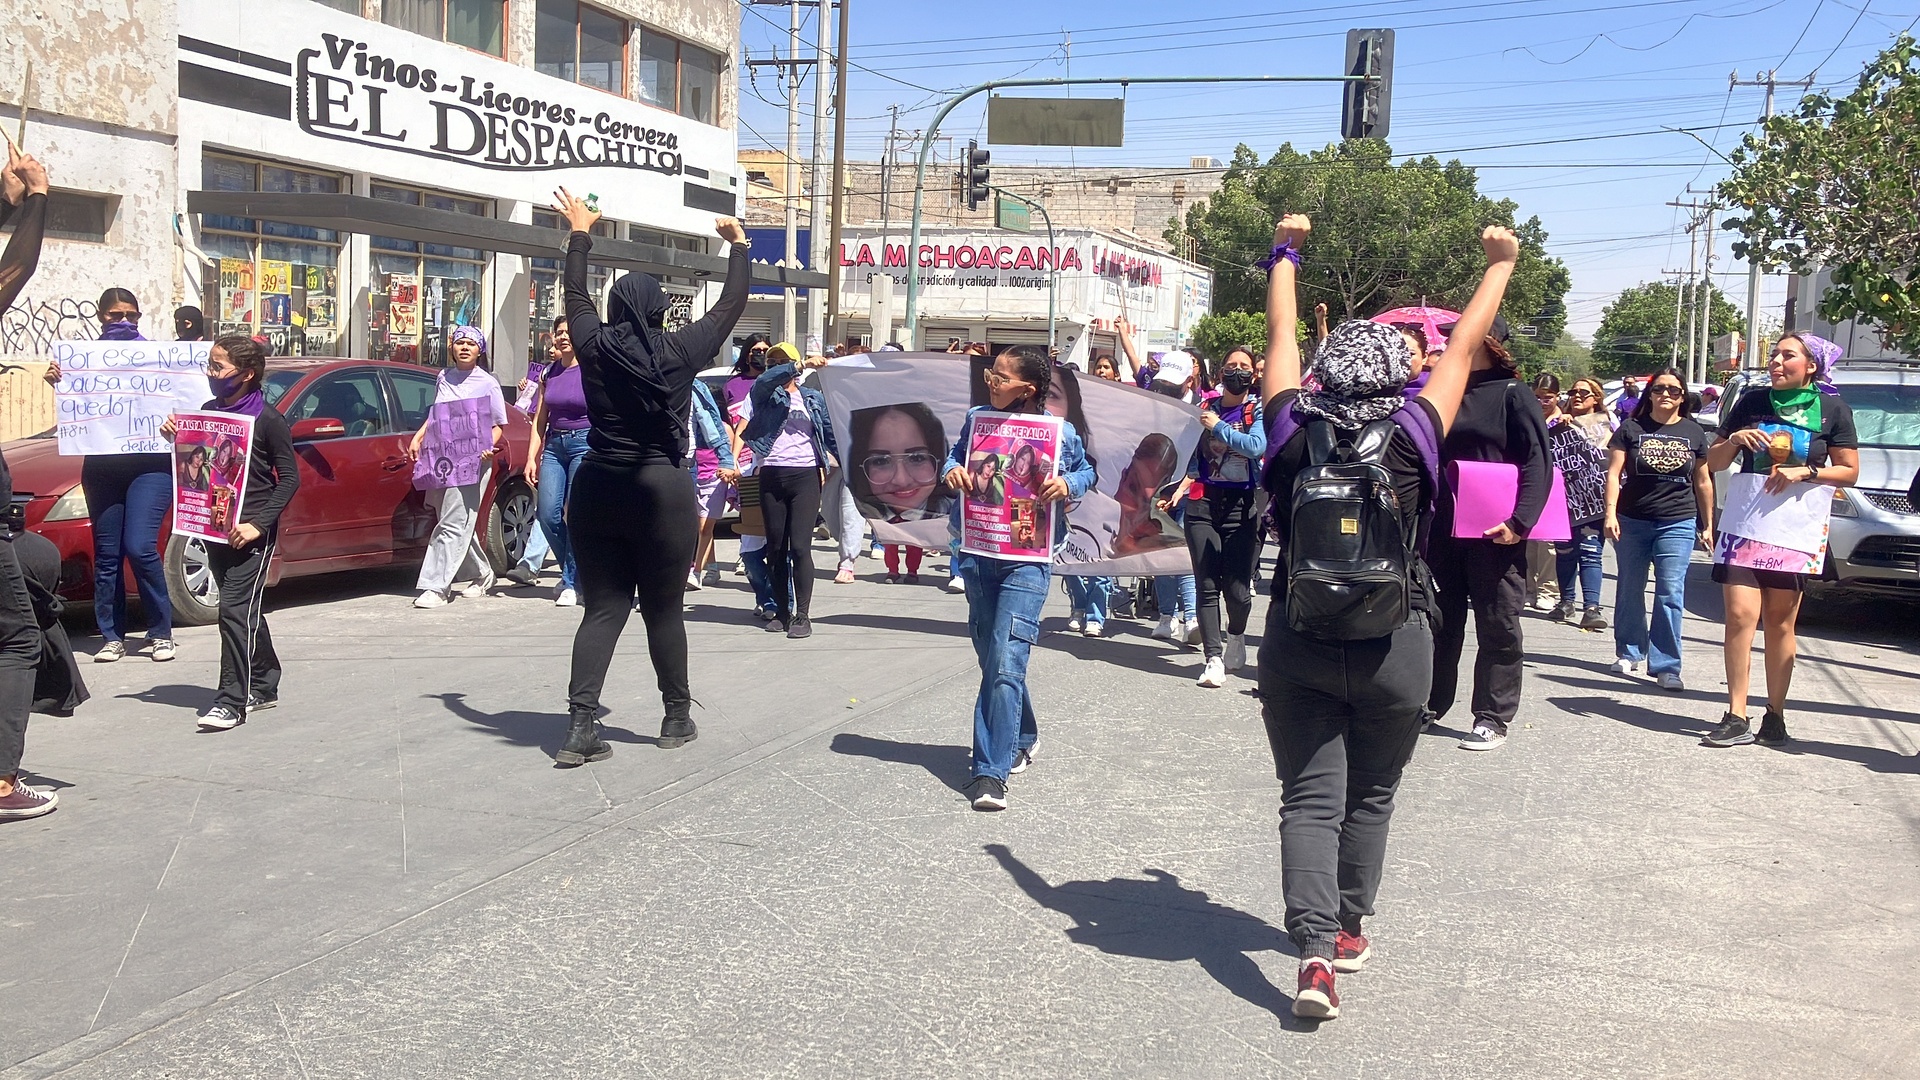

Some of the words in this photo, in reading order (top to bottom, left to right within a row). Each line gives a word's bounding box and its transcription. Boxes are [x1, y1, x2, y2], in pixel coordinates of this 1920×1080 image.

[308, 71, 407, 142] EL
[429, 100, 678, 172] DESPACHITO
[840, 243, 875, 267] LA
[959, 278, 965, 289] y
[966, 276, 997, 287] calidad
[58, 344, 96, 370] Por
[102, 348, 146, 367] ese
[1161, 361, 1183, 371] adidas
[130, 375, 172, 397] que
[61, 395, 124, 421] quedó
[59, 425, 88, 439] #8M
[177, 419, 203, 431] FALTA
[204, 421, 245, 437] ESMERALDA
[976, 423, 1000, 435] FALTA
[1001, 426, 1051, 440] ESMERALDA
[1638, 448, 1663, 456] NEW
[1664, 450, 1692, 459] YORK
[1065, 541, 1091, 563] ORAZÓN
[1753, 557, 1783, 570] #8M
